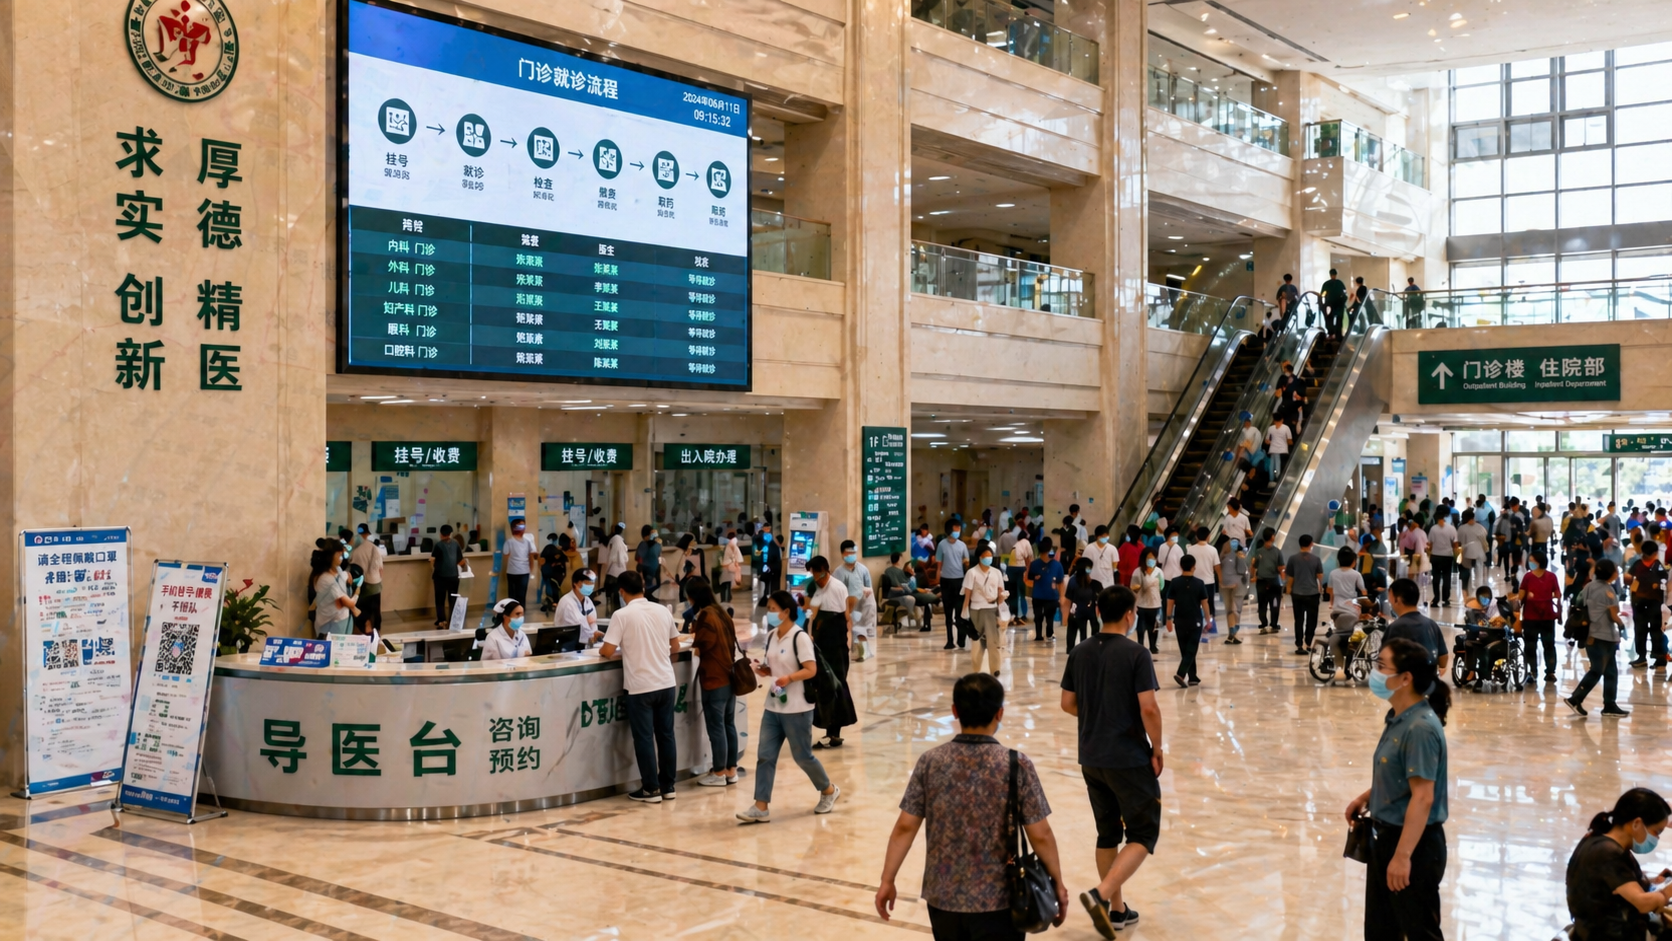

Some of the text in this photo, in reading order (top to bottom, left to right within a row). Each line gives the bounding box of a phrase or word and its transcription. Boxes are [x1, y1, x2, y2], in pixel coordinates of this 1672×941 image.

[518, 58, 619, 99] 门诊就诊流程
[693, 109, 731, 127] 09:15:32
[414, 243, 436, 255] 门诊
[115, 126, 165, 390] 求实 创新
[197, 138, 242, 391] 厚德 精医
[387, 260, 436, 276] 外科 门诊
[414, 284, 435, 296] 门诊
[417, 305, 438, 317] 门诊
[416, 325, 437, 337] 门诊
[417, 346, 439, 358] 门诊
[1464, 357, 1604, 379] 门诊楼 住院部
[395, 447, 460, 463] 挂号/收费
[562, 448, 616, 463] 挂号/收费
[682, 449, 736, 463] 出入院办理
[489, 716, 540, 743] 咨询
[260, 719, 461, 777] 导医台
[490, 746, 540, 774] 预约
